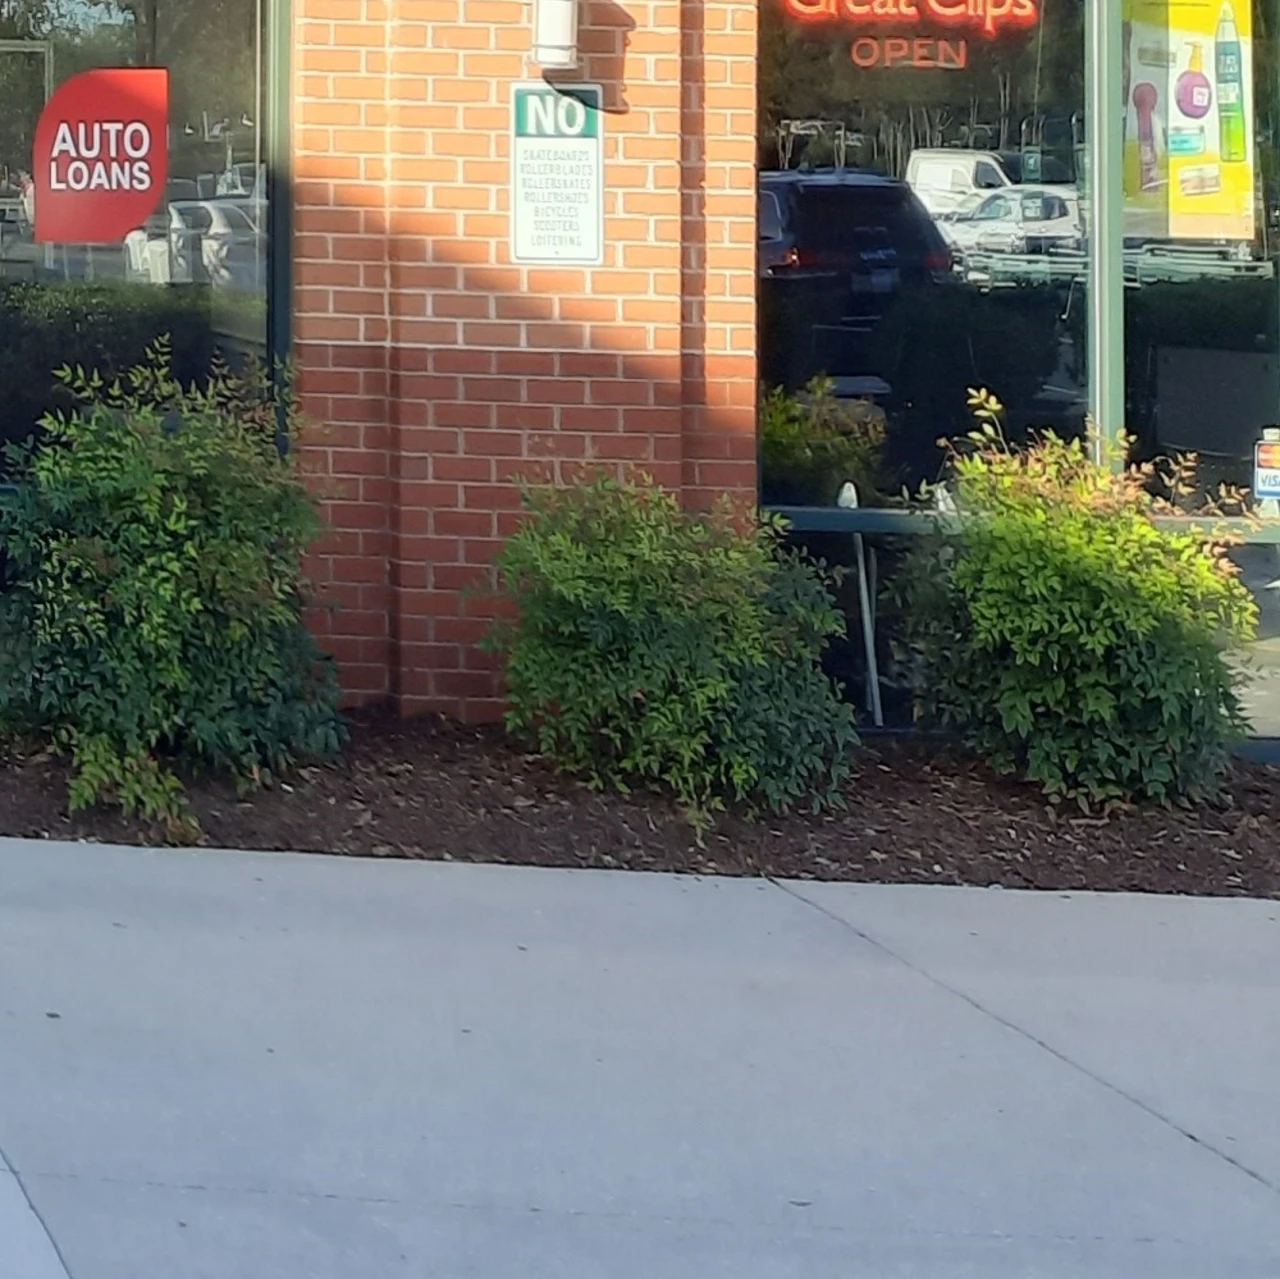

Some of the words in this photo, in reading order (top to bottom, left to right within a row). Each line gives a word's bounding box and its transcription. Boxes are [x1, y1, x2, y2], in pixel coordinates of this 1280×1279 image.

[851, 37, 967, 69] OPEN
[525, 94, 587, 136] NO
[51, 122, 151, 159] AUTO
[49, 160, 151, 192] LOANS
